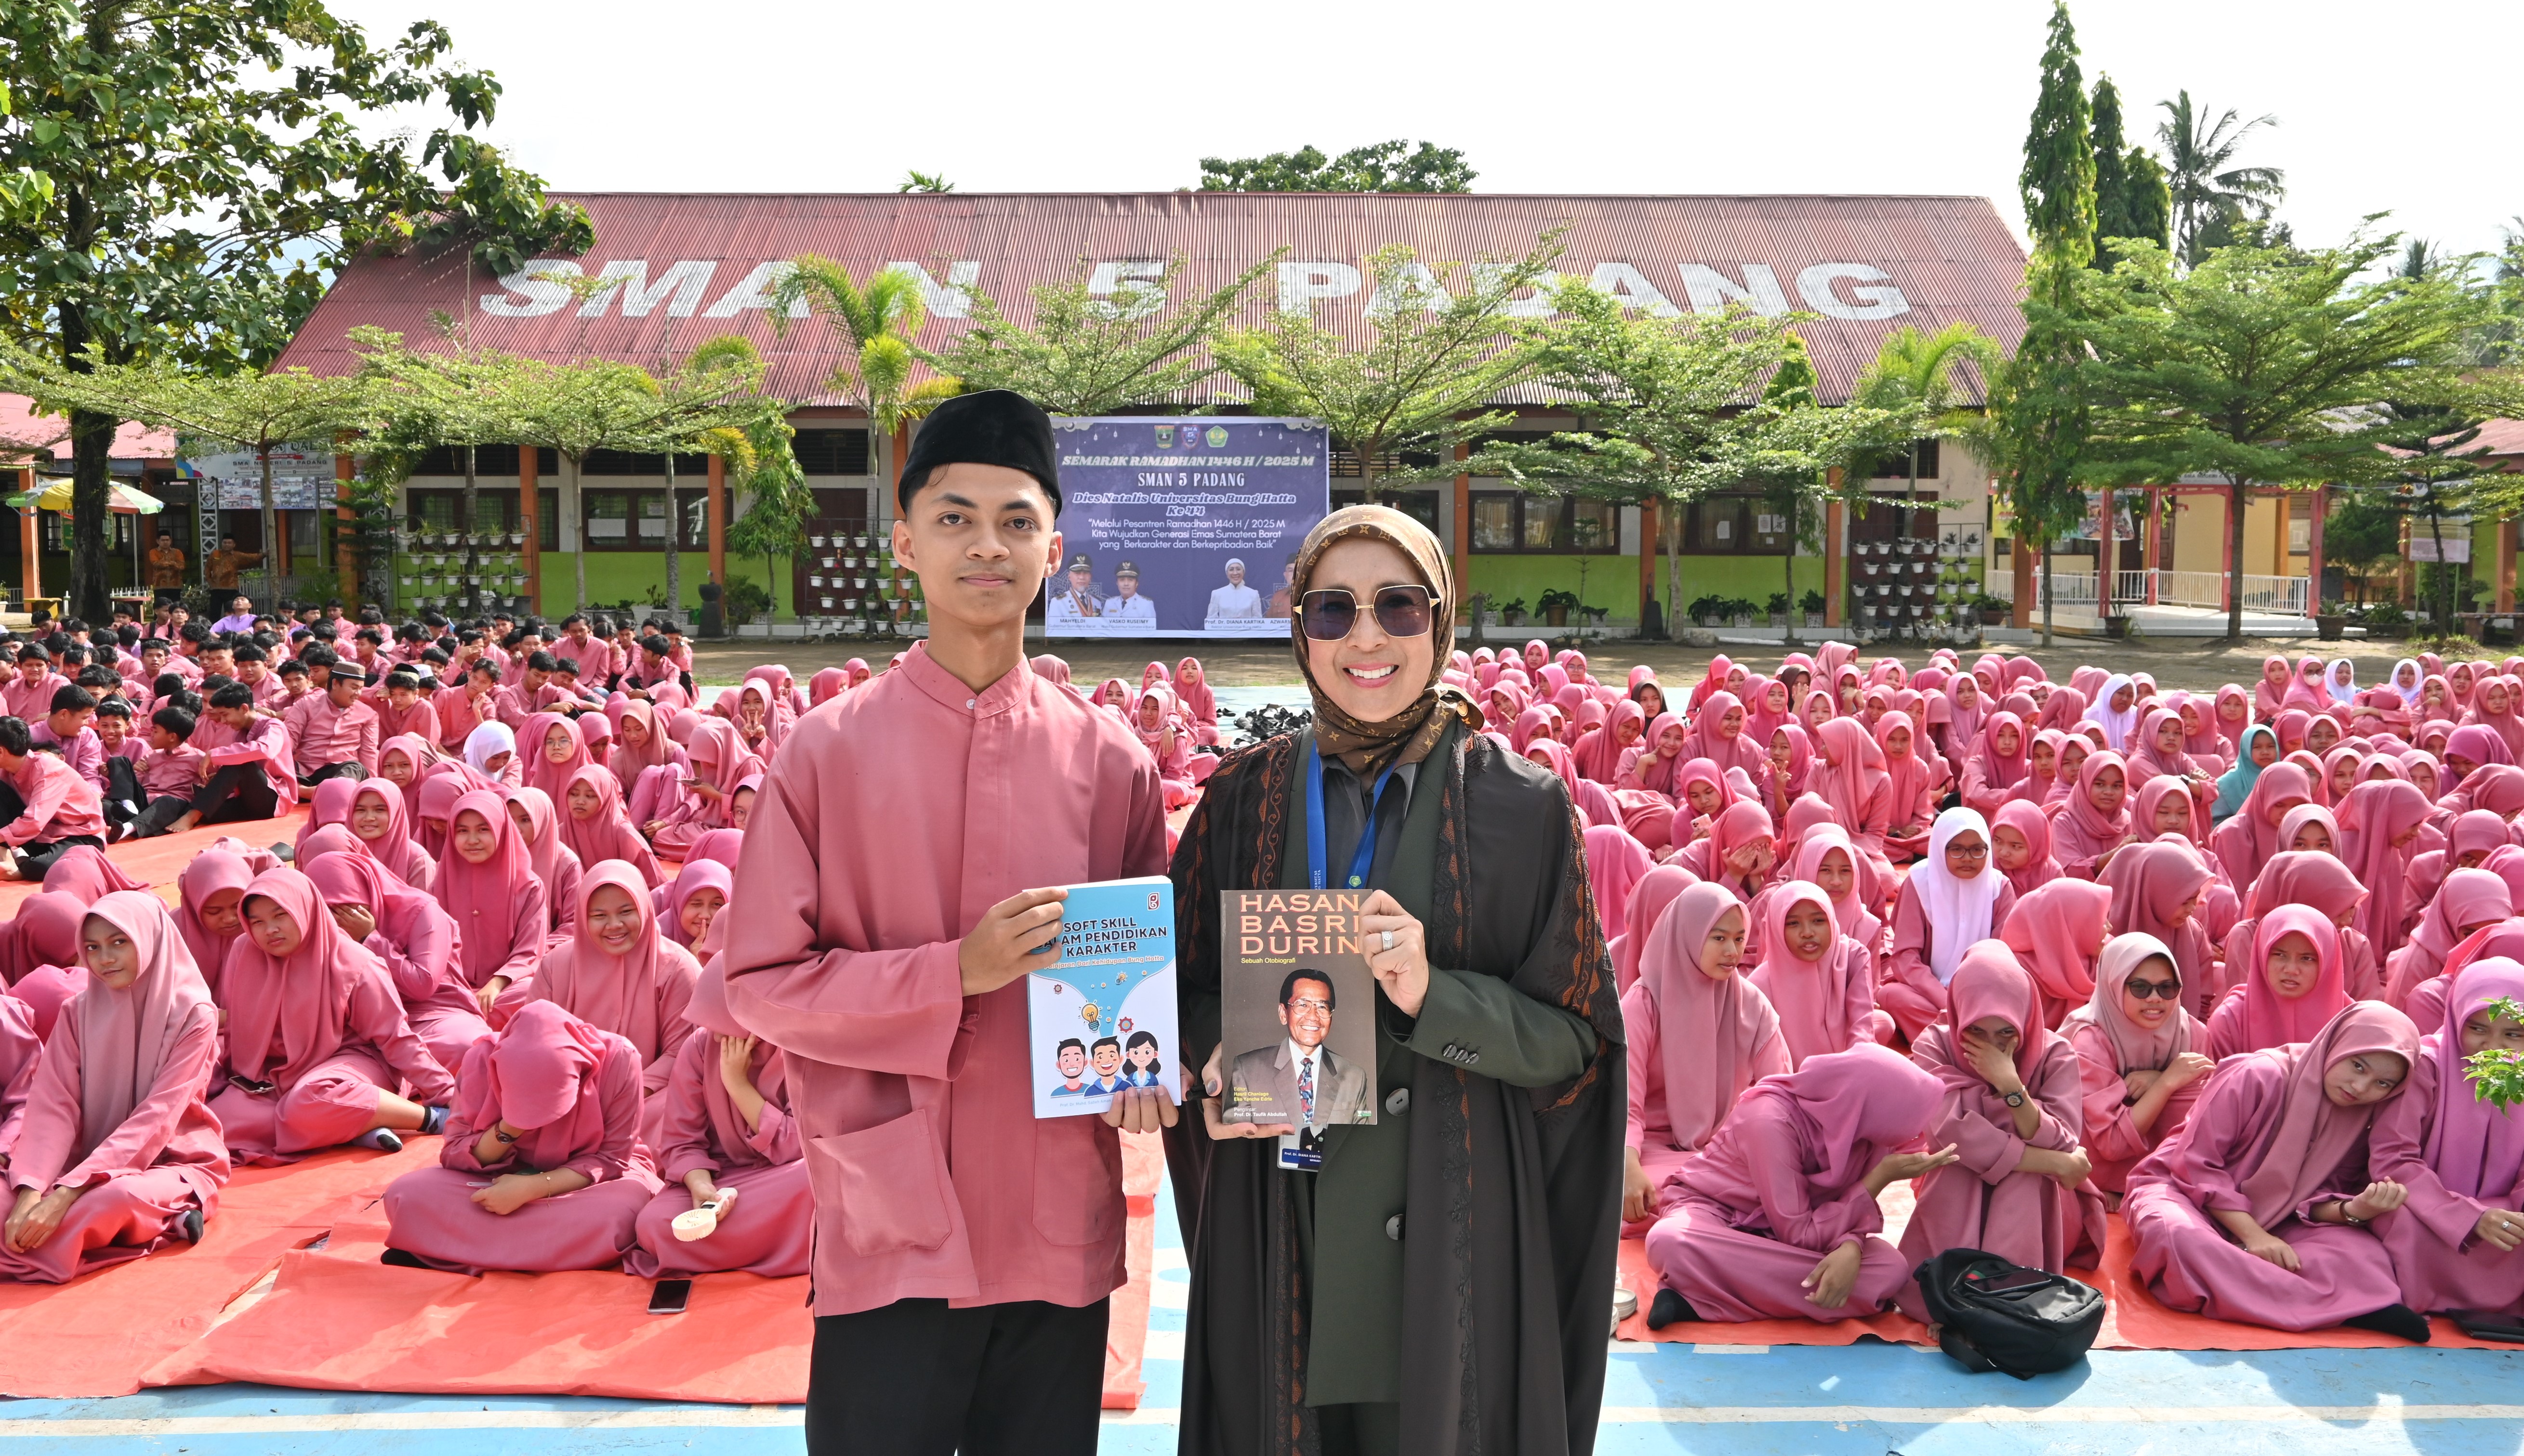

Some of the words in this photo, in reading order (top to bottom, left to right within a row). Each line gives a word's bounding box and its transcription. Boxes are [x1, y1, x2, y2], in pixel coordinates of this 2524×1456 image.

[480, 259, 980, 318] SMAN
[1085, 261, 1168, 320] 5
[1277, 261, 1911, 321] PADANG
[1062, 455, 1128, 466] SEMARAK
[1130, 455, 1206, 466] RAMADHAN
[1207, 456, 1242, 466] 1446
[1243, 456, 1255, 466] H
[1255, 456, 1264, 467] /
[1264, 456, 1299, 466] 2025
[1301, 456, 1314, 466] M
[1138, 472, 1172, 486] SMAN
[1178, 472, 1187, 486] 5
[1193, 472, 1244, 486] PADANG
[1072, 492, 1101, 503] Dies
[1101, 492, 1148, 504] Natalis
[1150, 492, 1224, 504] Universitas
[1224, 493, 1259, 506] Bung
[1260, 493, 1296, 504] Hatta
[1166, 506, 1185, 516] Ke
[1185, 506, 1205, 516] 44
[1088, 519, 1122, 527] “Melalui
[1123, 519, 1164, 527] Pesantren
[1166, 519, 1212, 527] Ramadhan
[1214, 519, 1234, 527] 1446
[1244, 519, 1249, 530] /
[1252, 519, 1275, 527] 2025
[1092, 529, 1107, 538] Kita
[1109, 529, 1149, 540] Wujudkan
[1151, 529, 1189, 538] Generasi
[1191, 530, 1214, 538] Emas
[1216, 530, 1256, 538] Sumatera
[1258, 530, 1282, 538] Barat
[1099, 541, 1120, 550] yang
[1124, 539, 1171, 548] Berkarakter
[1173, 539, 1189, 548] dan
[1191, 539, 1254, 551] Berkepribadian
[1240, 894, 1359, 912] HASAN
[1064, 920, 1097, 932] SOFT
[1100, 917, 1136, 929] SKILL
[1240, 915, 1359, 933] BASRI
[1085, 926, 1167, 943] PENDIDIKAN
[1066, 941, 1136, 957] KARAKTER
[1240, 936, 1361, 955] DURIN
